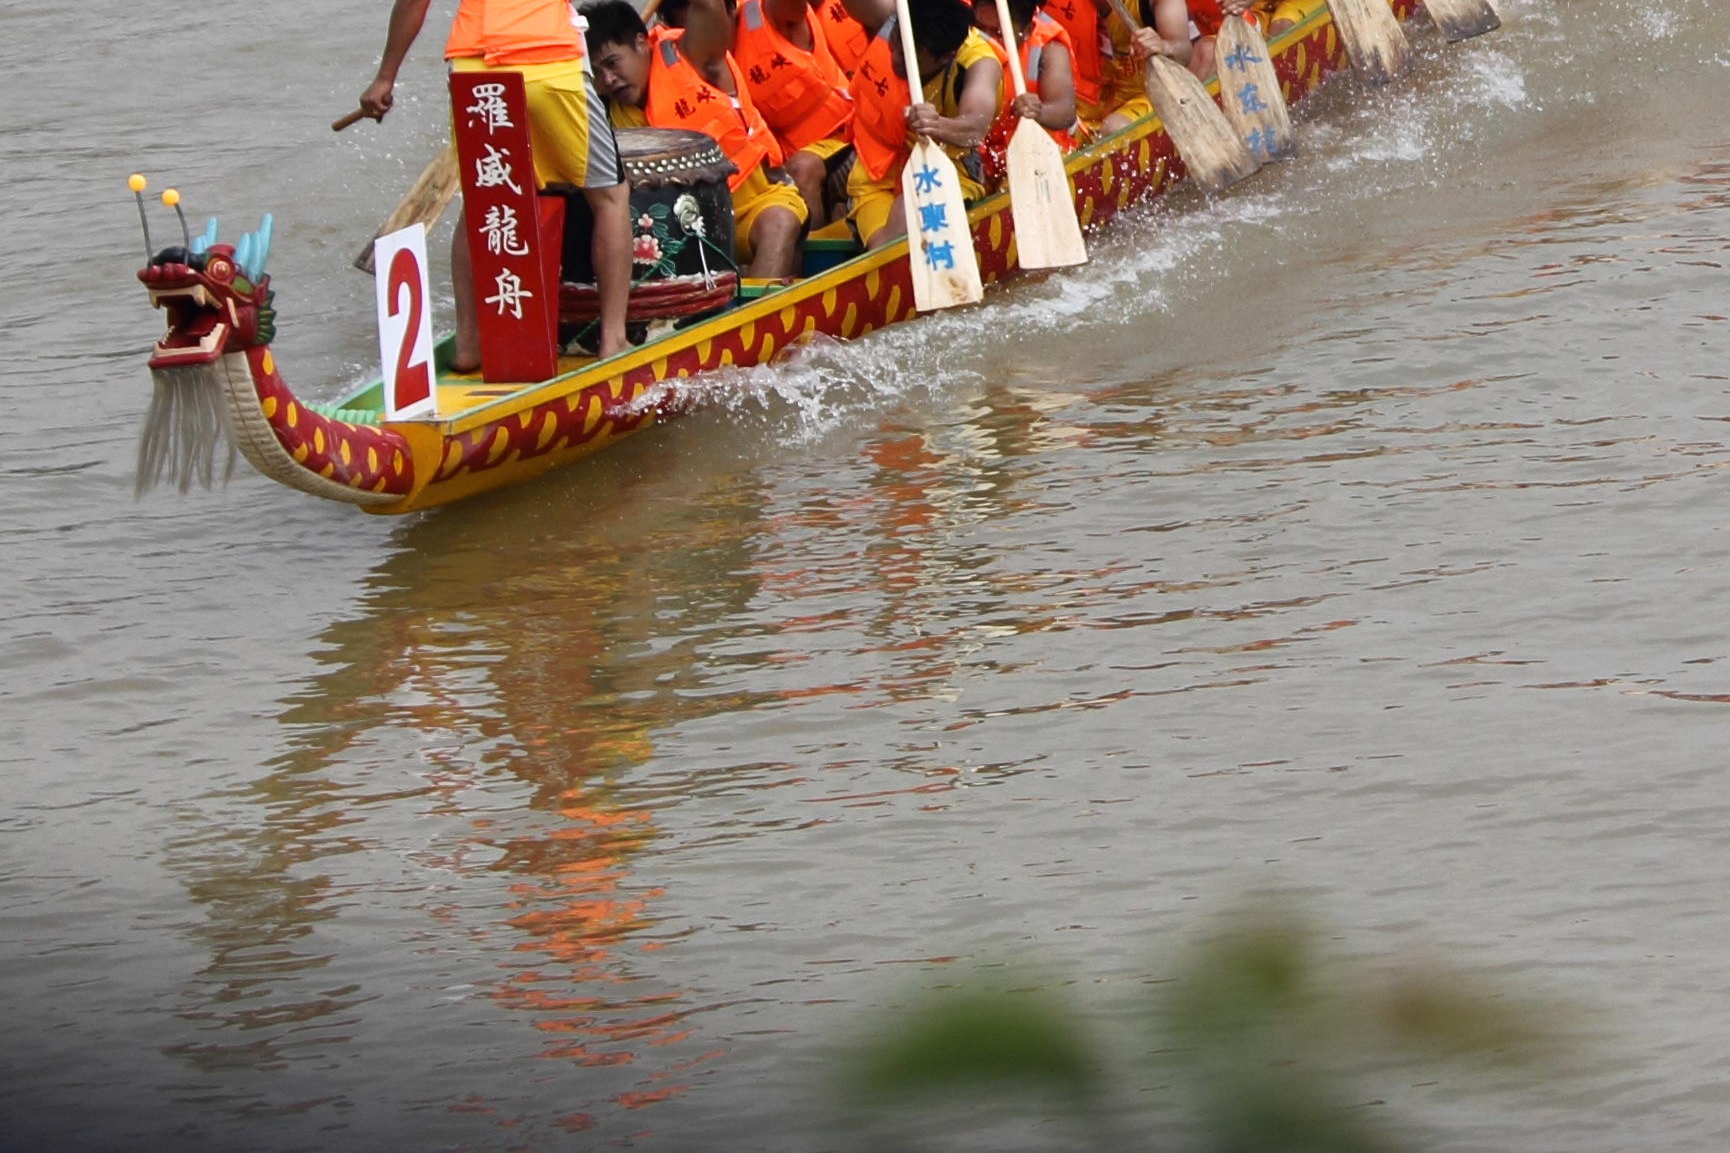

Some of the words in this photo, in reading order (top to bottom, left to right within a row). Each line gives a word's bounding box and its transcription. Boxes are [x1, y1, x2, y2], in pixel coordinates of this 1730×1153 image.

[466, 83, 533, 320] 羅威龍舟
[388, 247, 430, 412] 2
